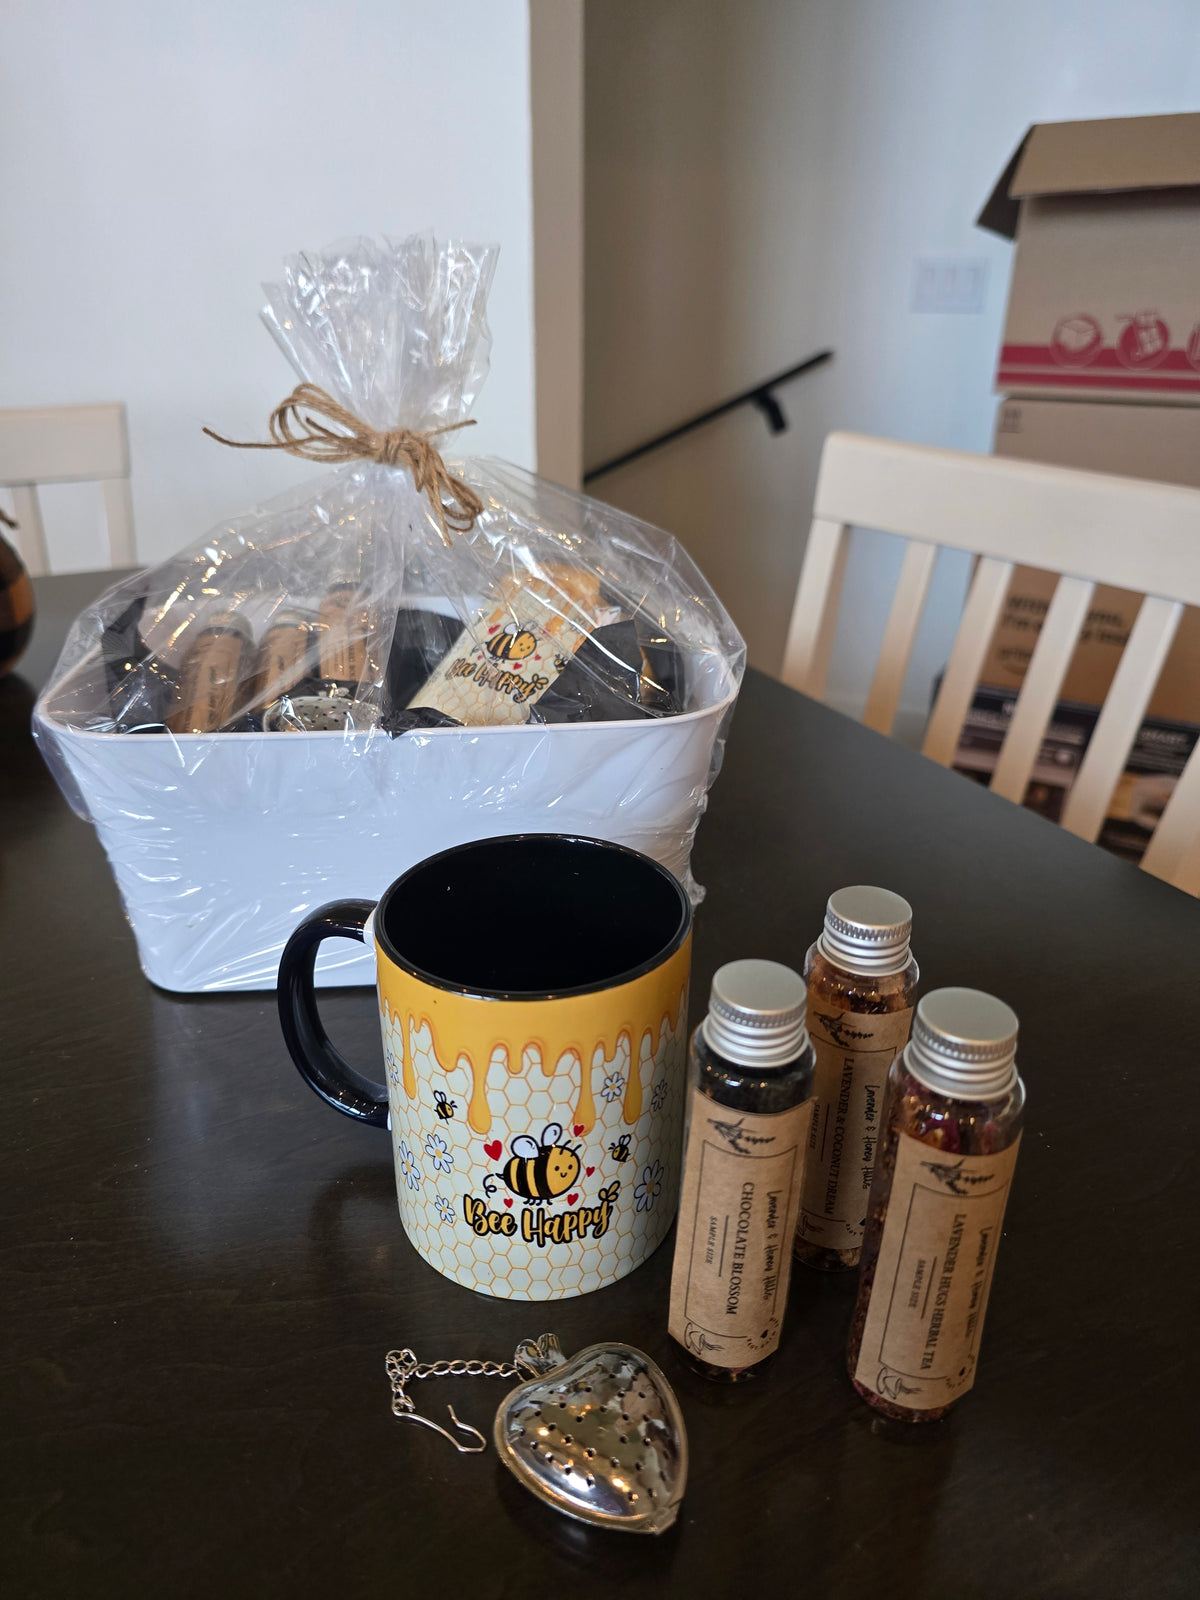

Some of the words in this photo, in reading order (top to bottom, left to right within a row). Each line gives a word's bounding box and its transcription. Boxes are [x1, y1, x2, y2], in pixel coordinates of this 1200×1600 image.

[836, 1057, 855, 1114] LAVENDER
[829, 1126, 847, 1178] COCONUT
[463, 1193, 518, 1237] Bee
[521, 1180, 621, 1248] Happy
[824, 1180, 839, 1215] DREAM
[707, 1216, 718, 1246] SAMPLE
[734, 1181, 755, 1260] CHOCOLATE
[704, 1246, 714, 1264] SIZE
[942, 1212, 967, 1274] LAVENDER
[725, 1261, 745, 1315] BLOSSOM
[912, 1258, 926, 1290] SAMPLE
[934, 1275, 952, 1307] HUGS
[907, 1290, 919, 1309] SIZE
[926, 1307, 945, 1350] HERBAL
[920, 1350, 935, 1371] TEA
